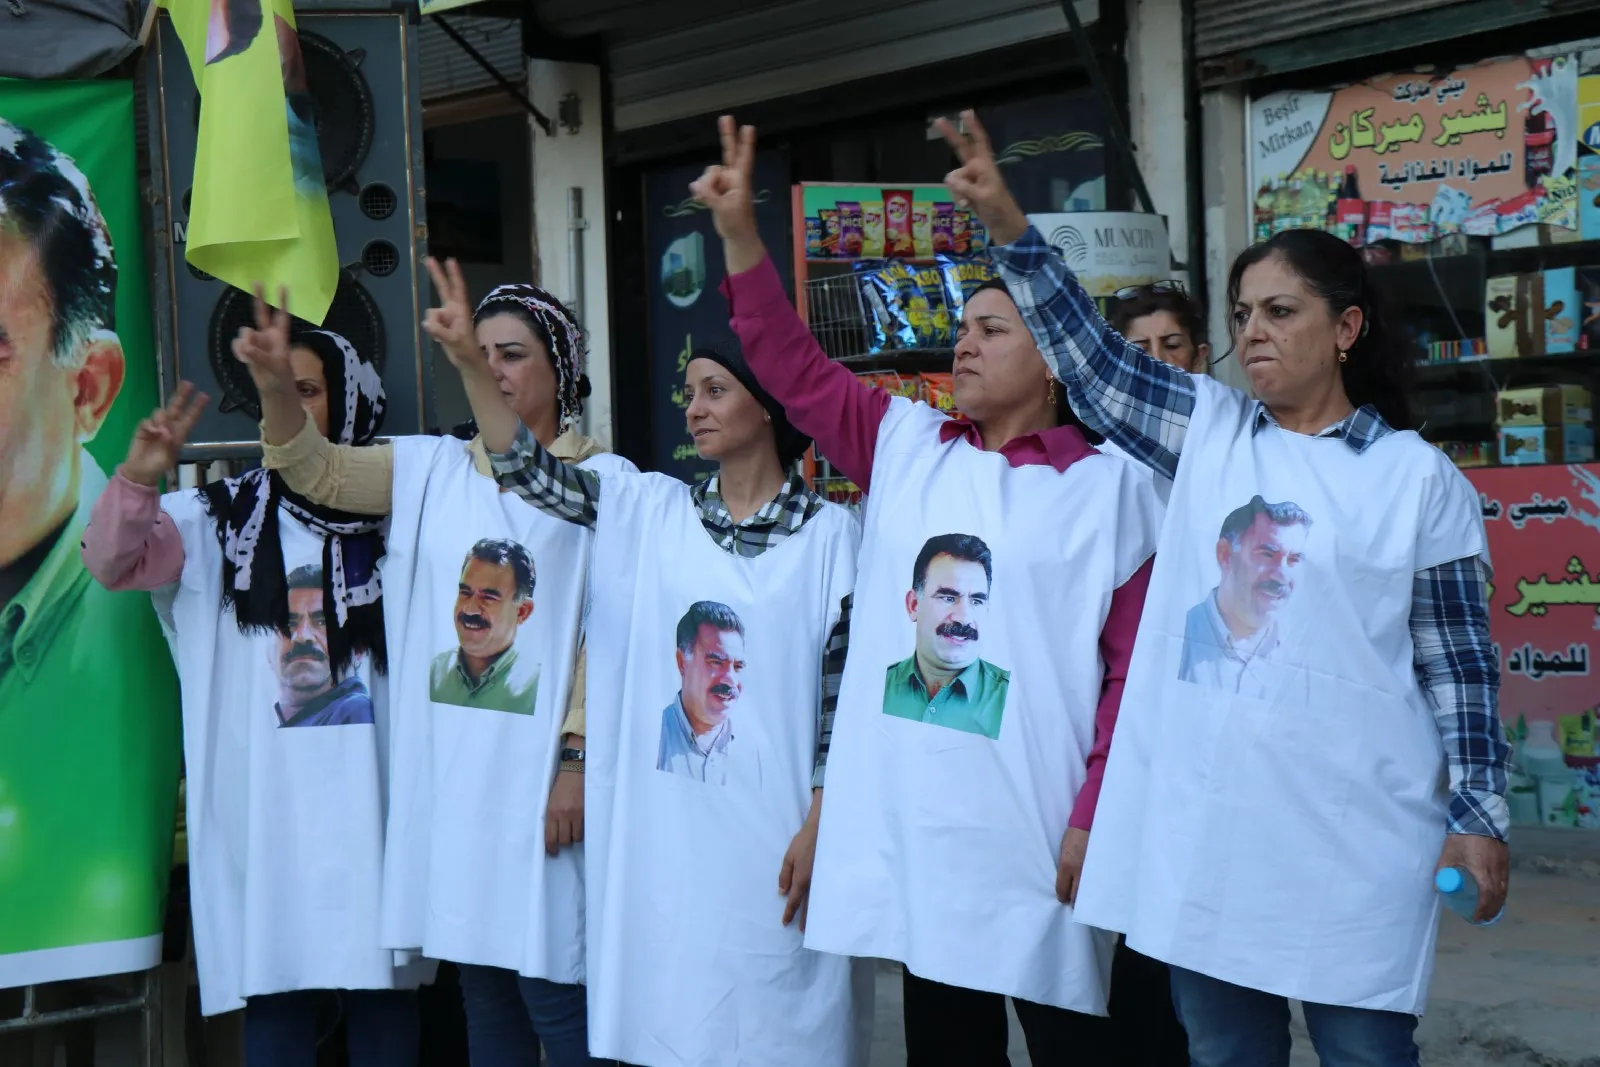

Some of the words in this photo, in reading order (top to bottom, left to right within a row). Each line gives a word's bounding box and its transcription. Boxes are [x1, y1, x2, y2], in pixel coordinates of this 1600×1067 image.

[1328, 106, 1426, 161] ميركان
[1432, 92, 1508, 147] بشير
[1377, 157, 1455, 192] الغذائية
[1456, 150, 1513, 183] للمواد
[1508, 493, 1572, 530] ميني
[1507, 642, 1591, 682] للمواد
